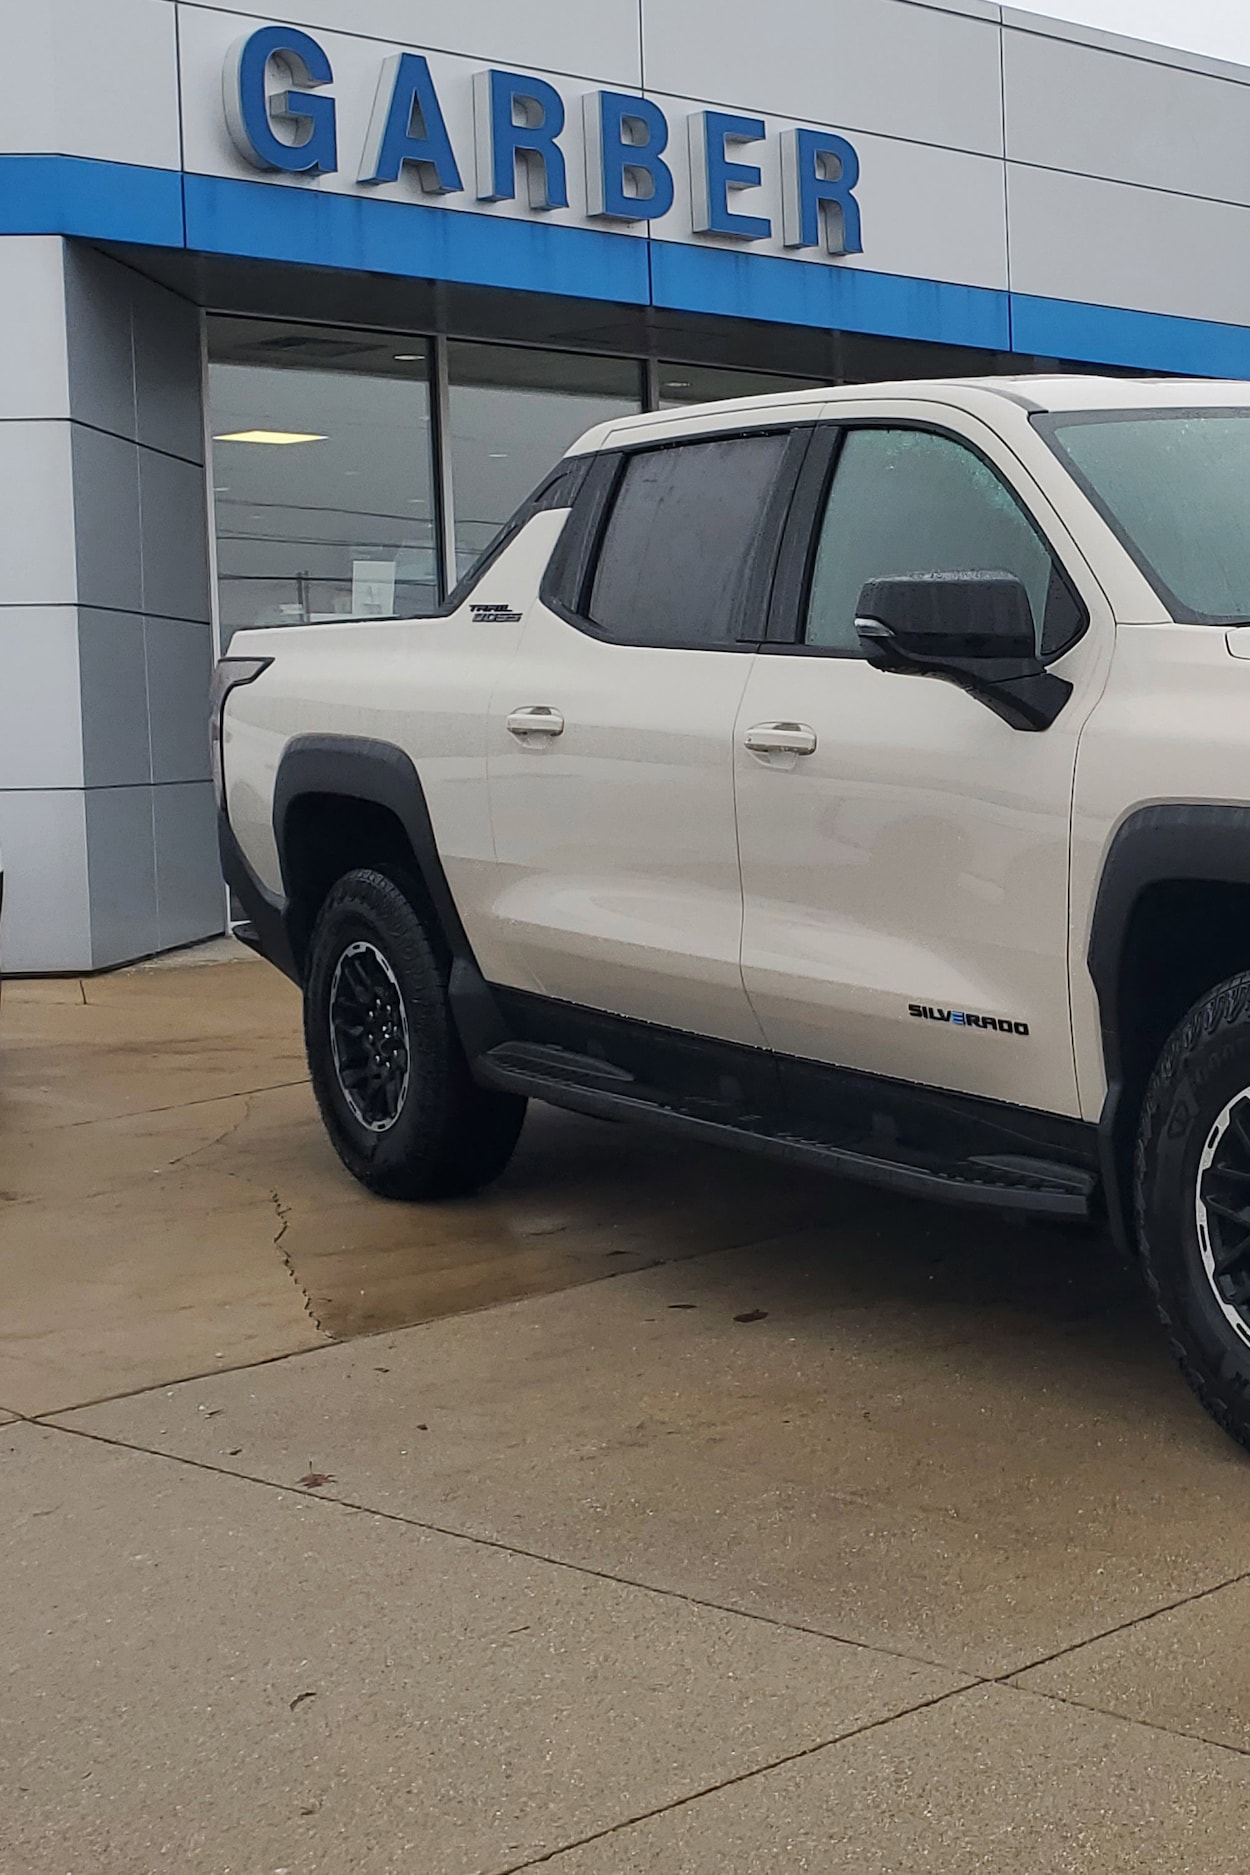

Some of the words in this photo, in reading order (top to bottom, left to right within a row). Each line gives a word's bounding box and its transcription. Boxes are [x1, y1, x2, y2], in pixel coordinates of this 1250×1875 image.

[227, 25, 864, 256] GARBER
[469, 604, 513, 613] TRAIL
[908, 1003, 1030, 1036] SILVERADO
